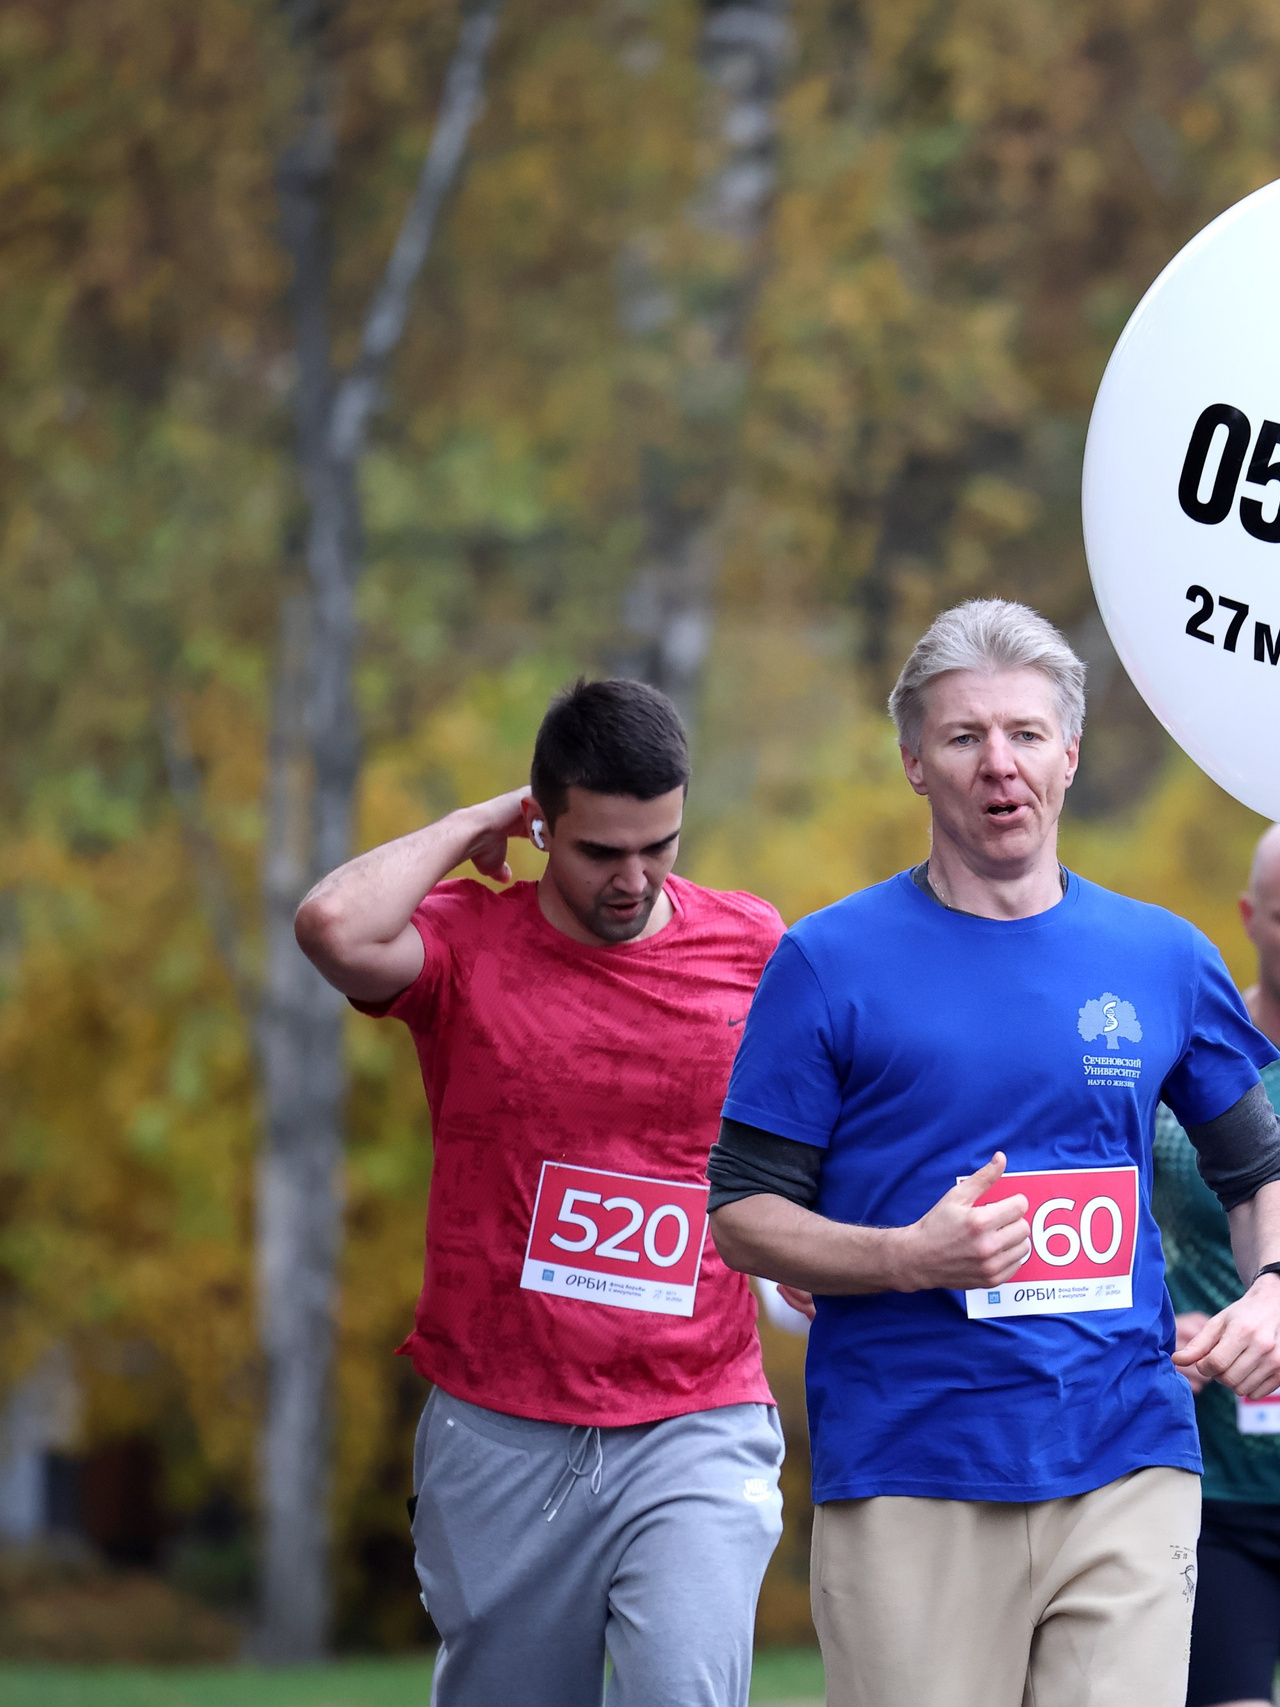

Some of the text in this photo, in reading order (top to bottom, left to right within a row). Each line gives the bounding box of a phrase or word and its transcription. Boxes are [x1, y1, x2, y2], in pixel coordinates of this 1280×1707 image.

[549, 1188, 690, 1267] 520
[986, 1195, 1123, 1267] 60
[565, 1274, 607, 1292] ОРБИ
[1014, 1287, 1056, 1303] ОРБИ
